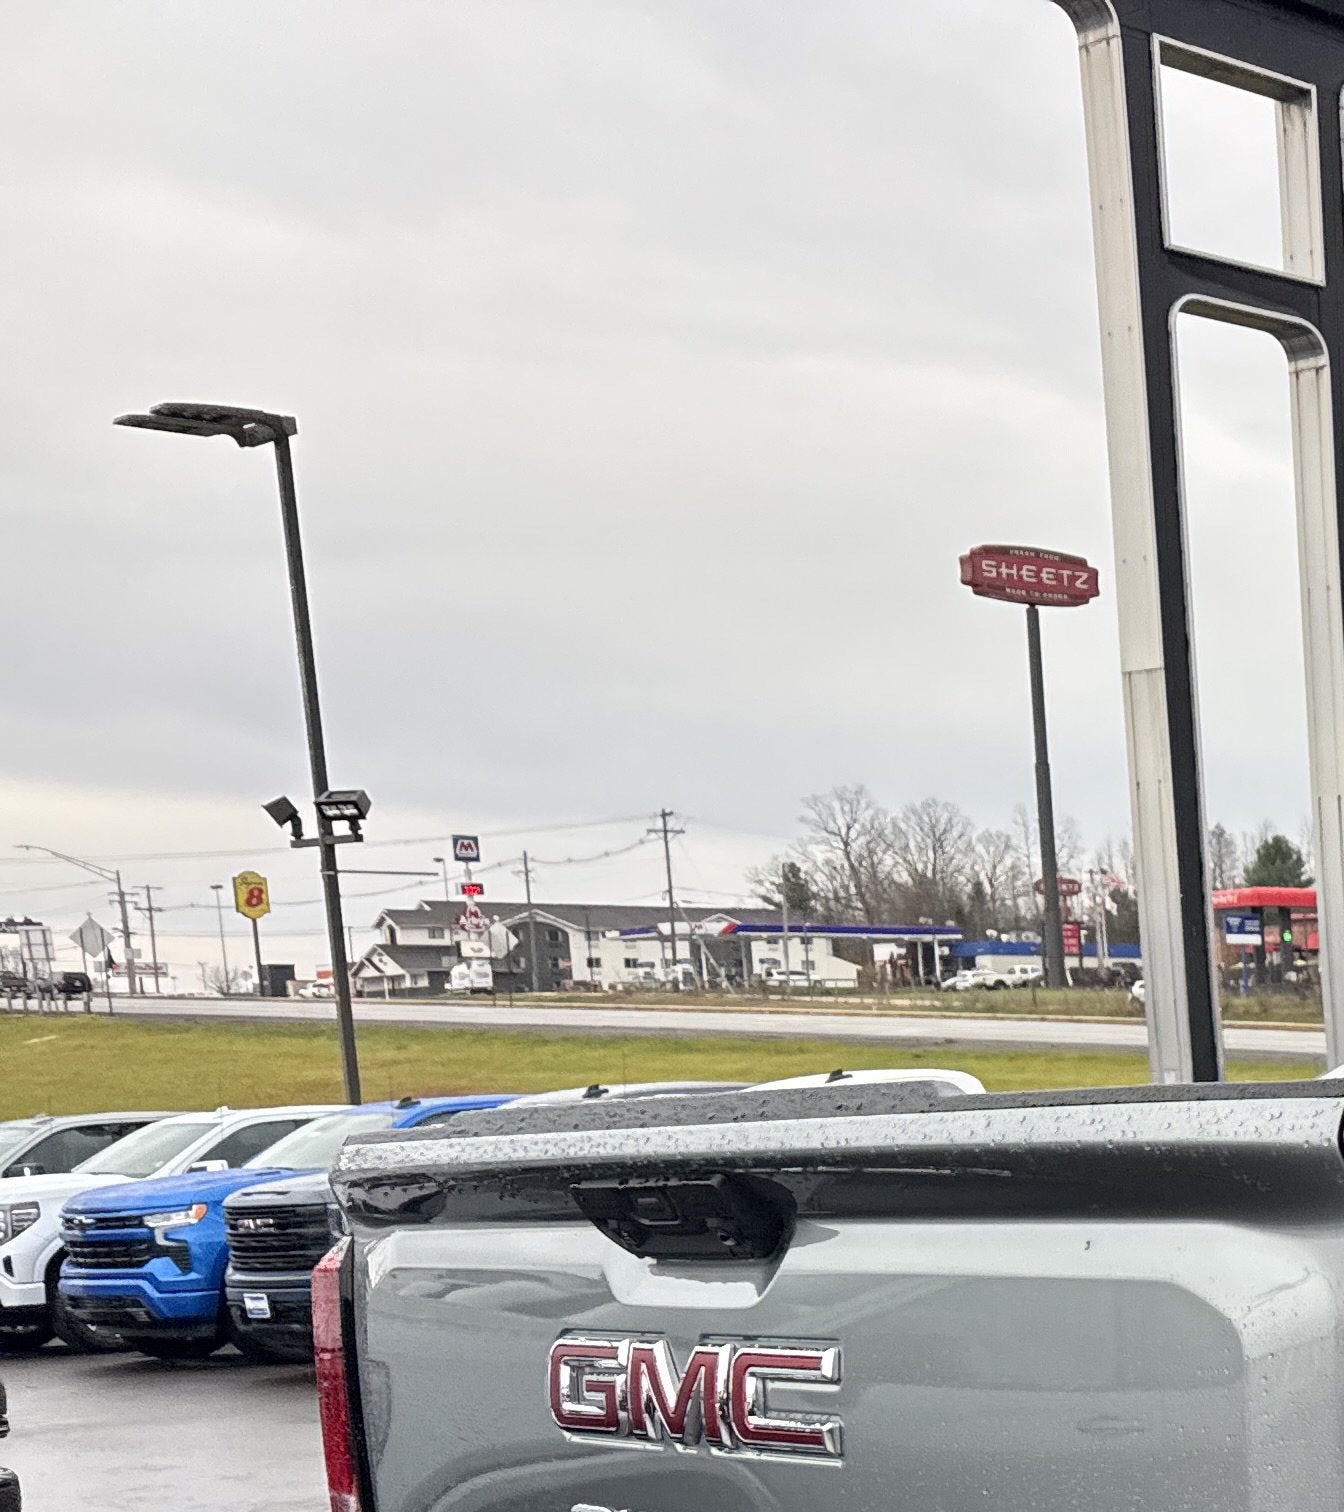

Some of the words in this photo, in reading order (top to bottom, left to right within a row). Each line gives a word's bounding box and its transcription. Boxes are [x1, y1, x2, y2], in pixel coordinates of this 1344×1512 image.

[981, 559, 1089, 590] SHEETZ
[245, 886, 264, 908] 8
[549, 1334, 845, 1458] GMC
